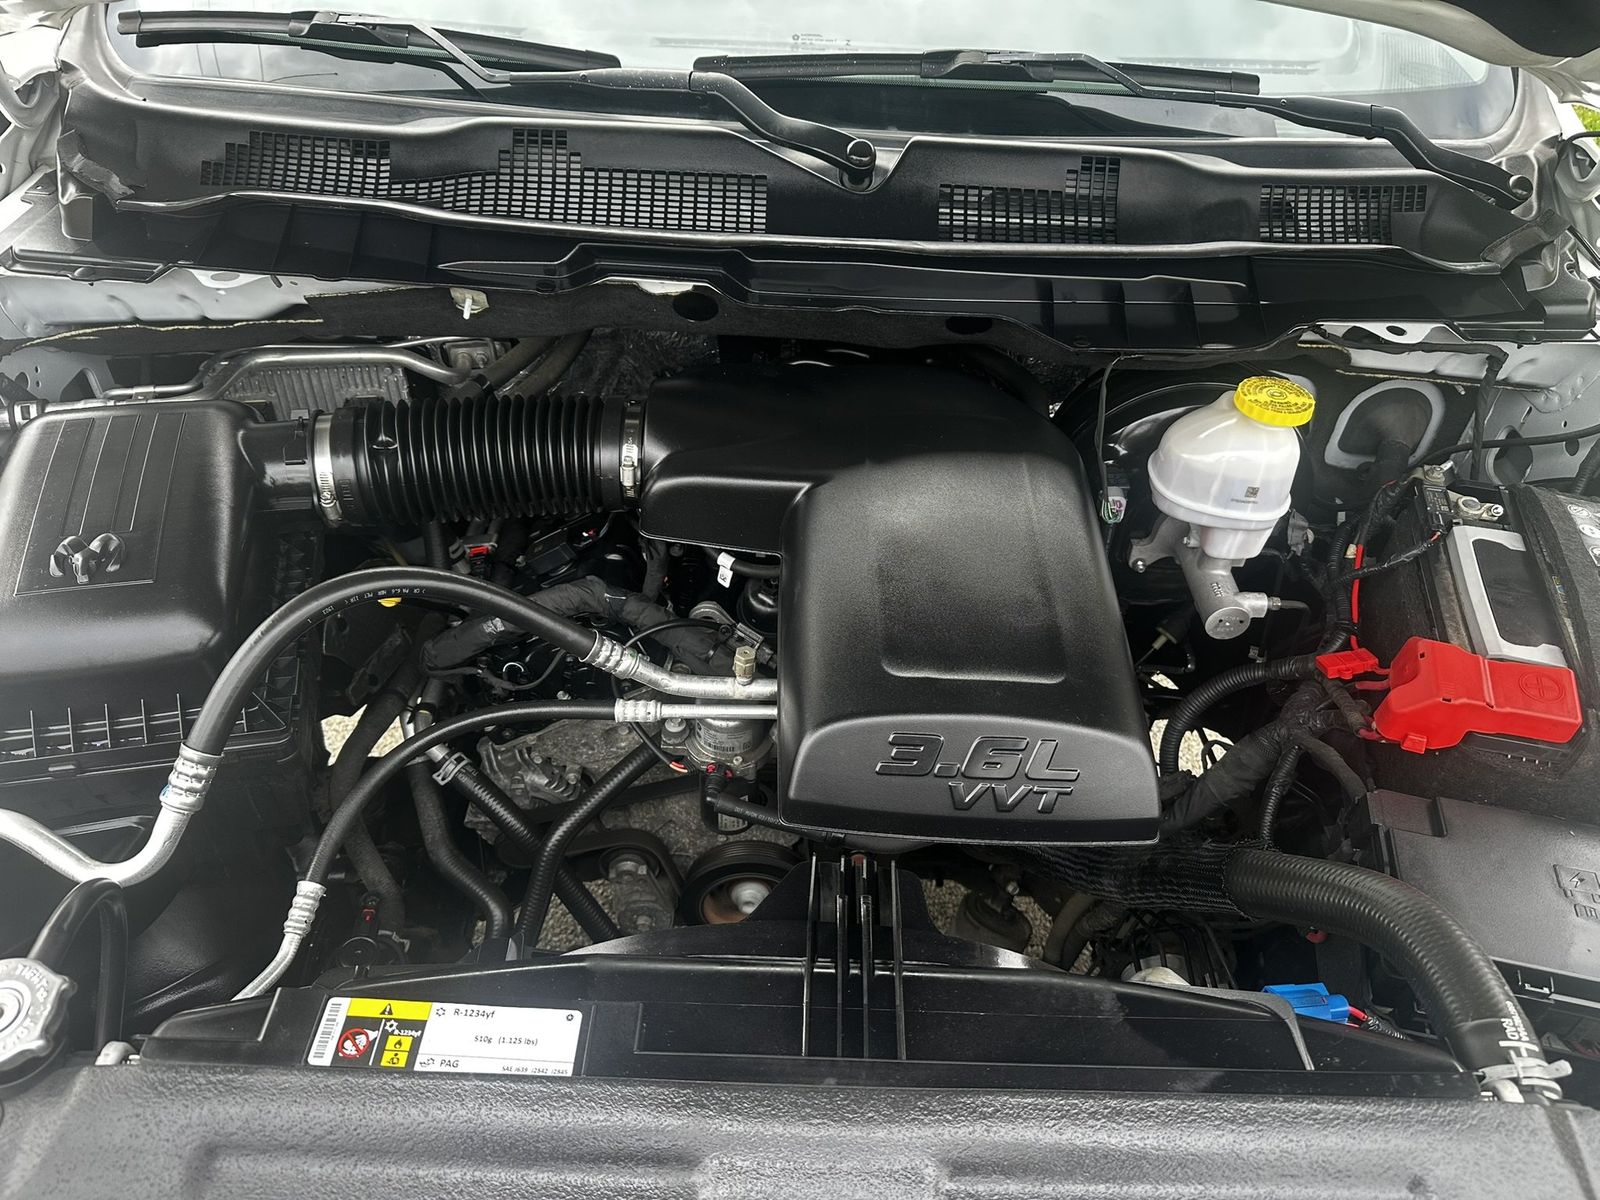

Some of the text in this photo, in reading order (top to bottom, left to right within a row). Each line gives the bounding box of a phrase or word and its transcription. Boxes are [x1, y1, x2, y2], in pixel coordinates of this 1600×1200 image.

[875, 732, 1080, 781] 3.6L
[948, 781, 1074, 813] VVT
[453, 1008, 495, 1019] R-1234yf
[1500, 1018, 1520, 1040] RAD
[498, 1036, 522, 1045] (1.125
[524, 1037, 538, 1046] lbs)
[439, 1058, 460, 1068] PAG
